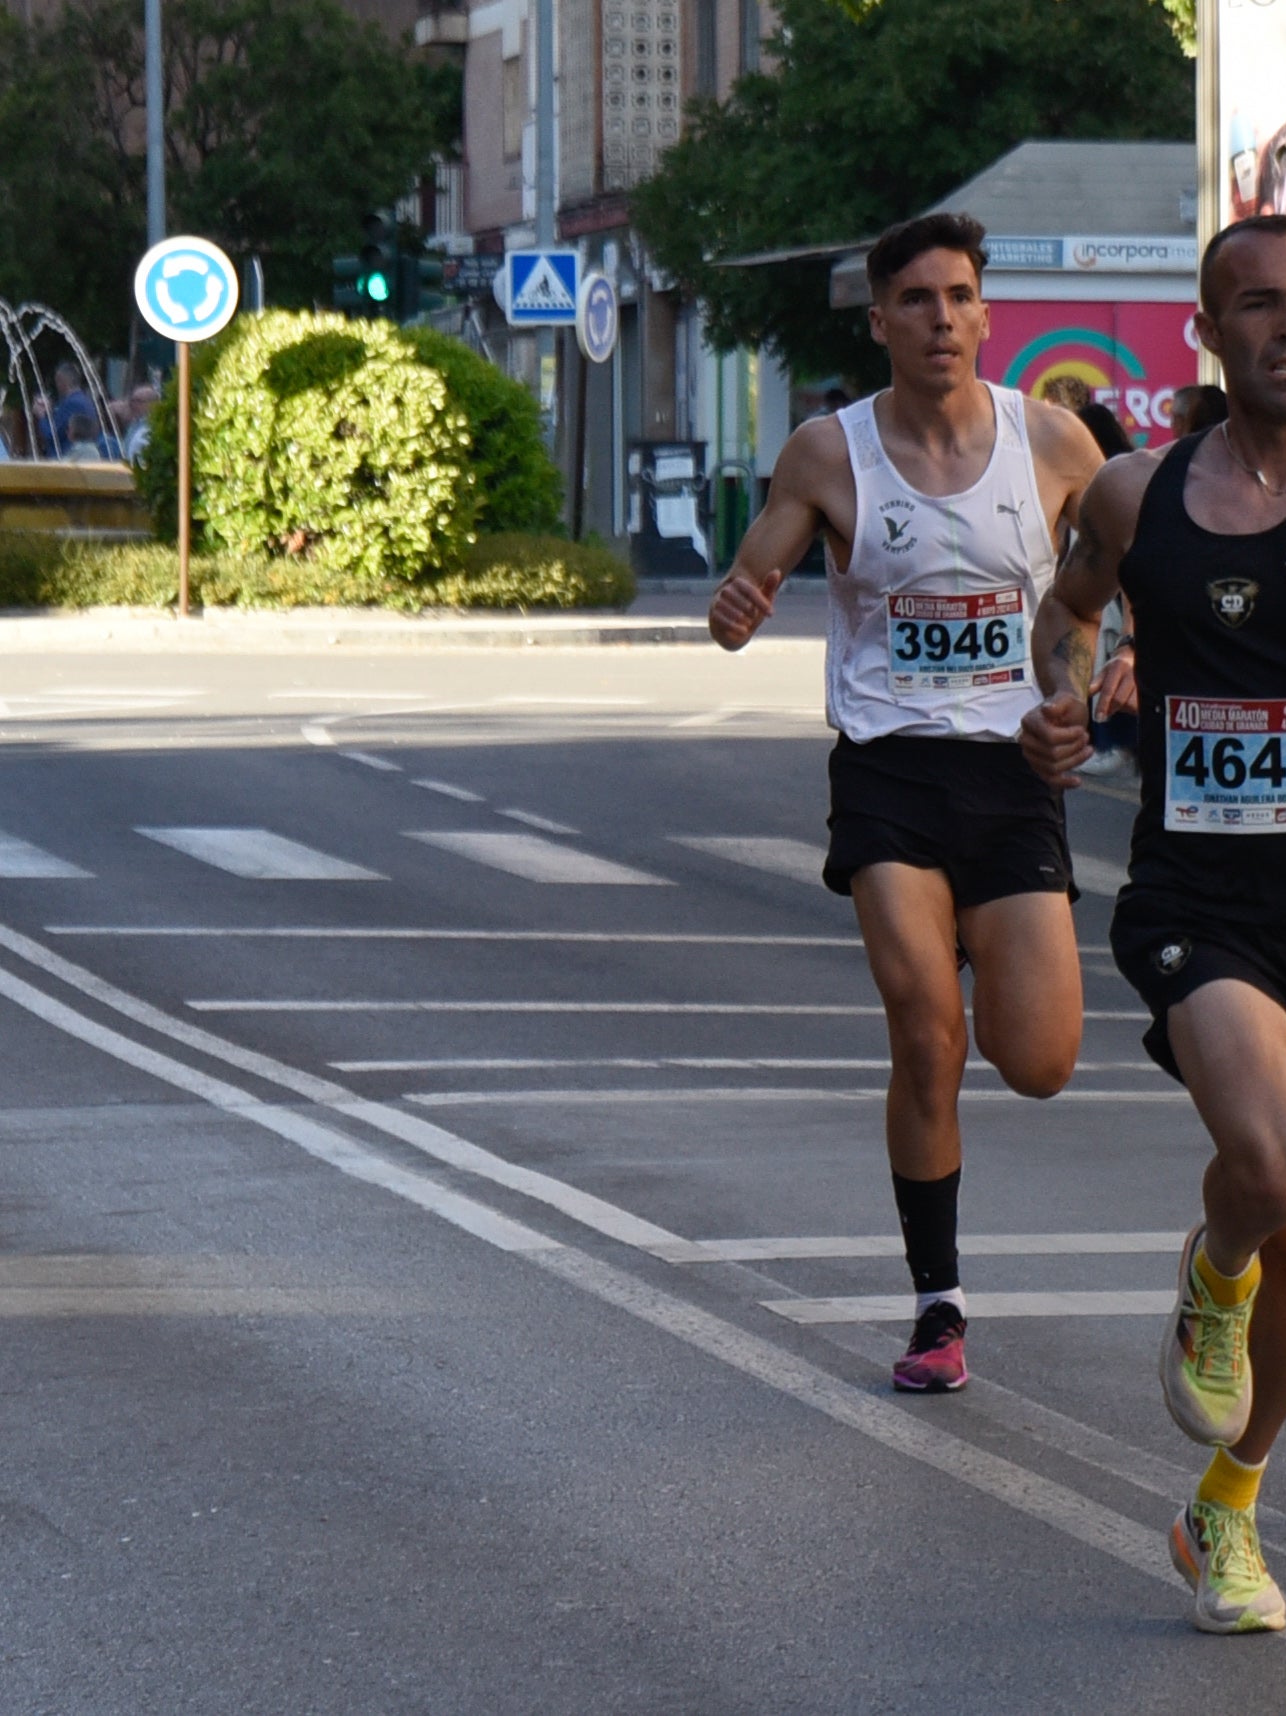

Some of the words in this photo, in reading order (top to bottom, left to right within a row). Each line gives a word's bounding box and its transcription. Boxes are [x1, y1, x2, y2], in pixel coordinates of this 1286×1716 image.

[1081, 243, 1168, 262] incorpora
[894, 597, 916, 617] 40
[895, 619, 1009, 662] 3946
[1175, 701, 1200, 729] 40
[1201, 708, 1226, 720] MEDIA
[1281, 718, 1286, 730] 4
